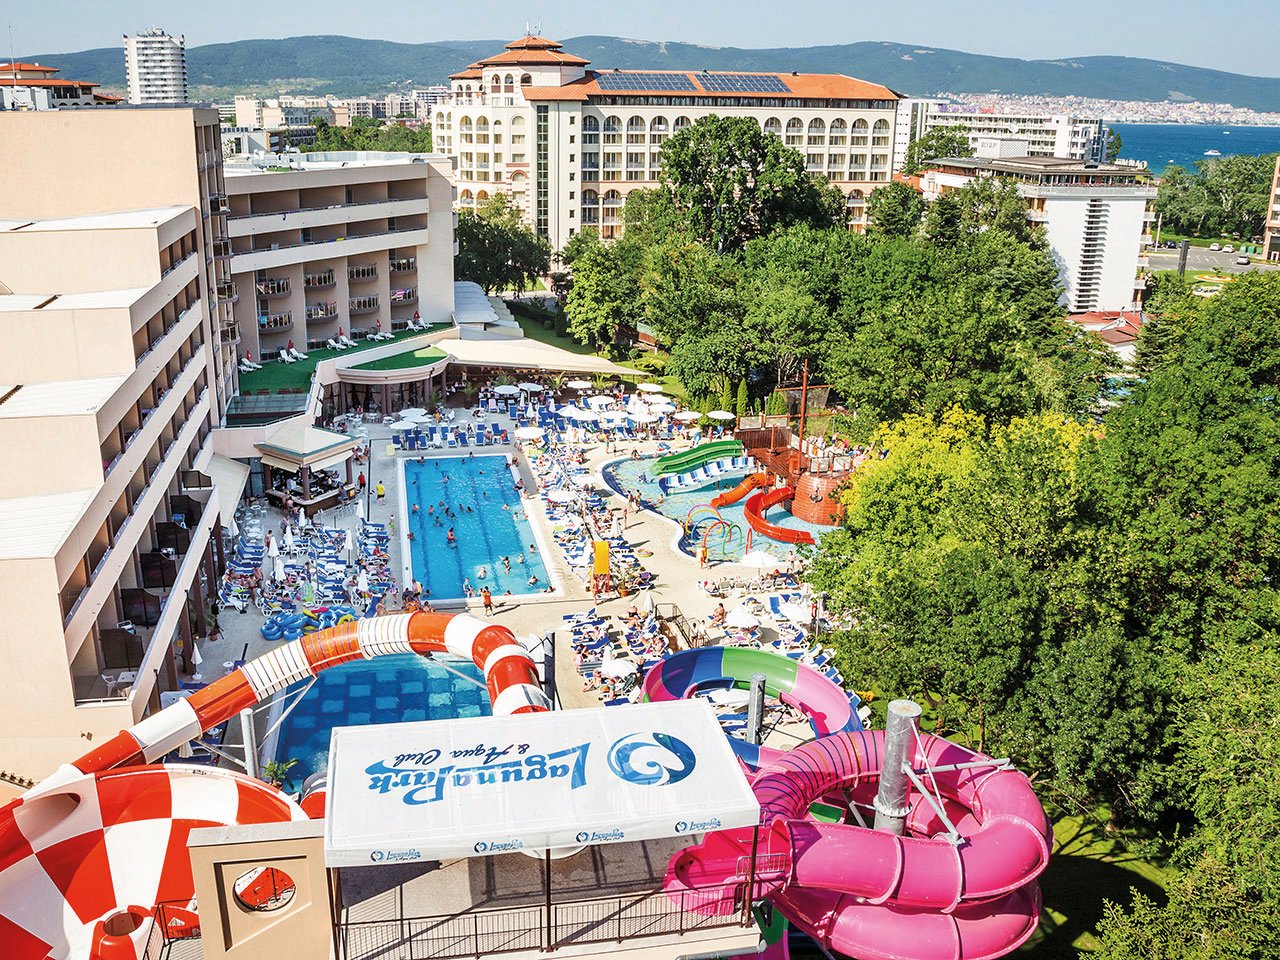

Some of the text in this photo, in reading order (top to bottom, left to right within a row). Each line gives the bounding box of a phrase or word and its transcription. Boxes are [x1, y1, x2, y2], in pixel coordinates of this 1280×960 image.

[365, 742, 591, 806] Laguna Park
[392, 743, 530, 768] & Aqua Club
